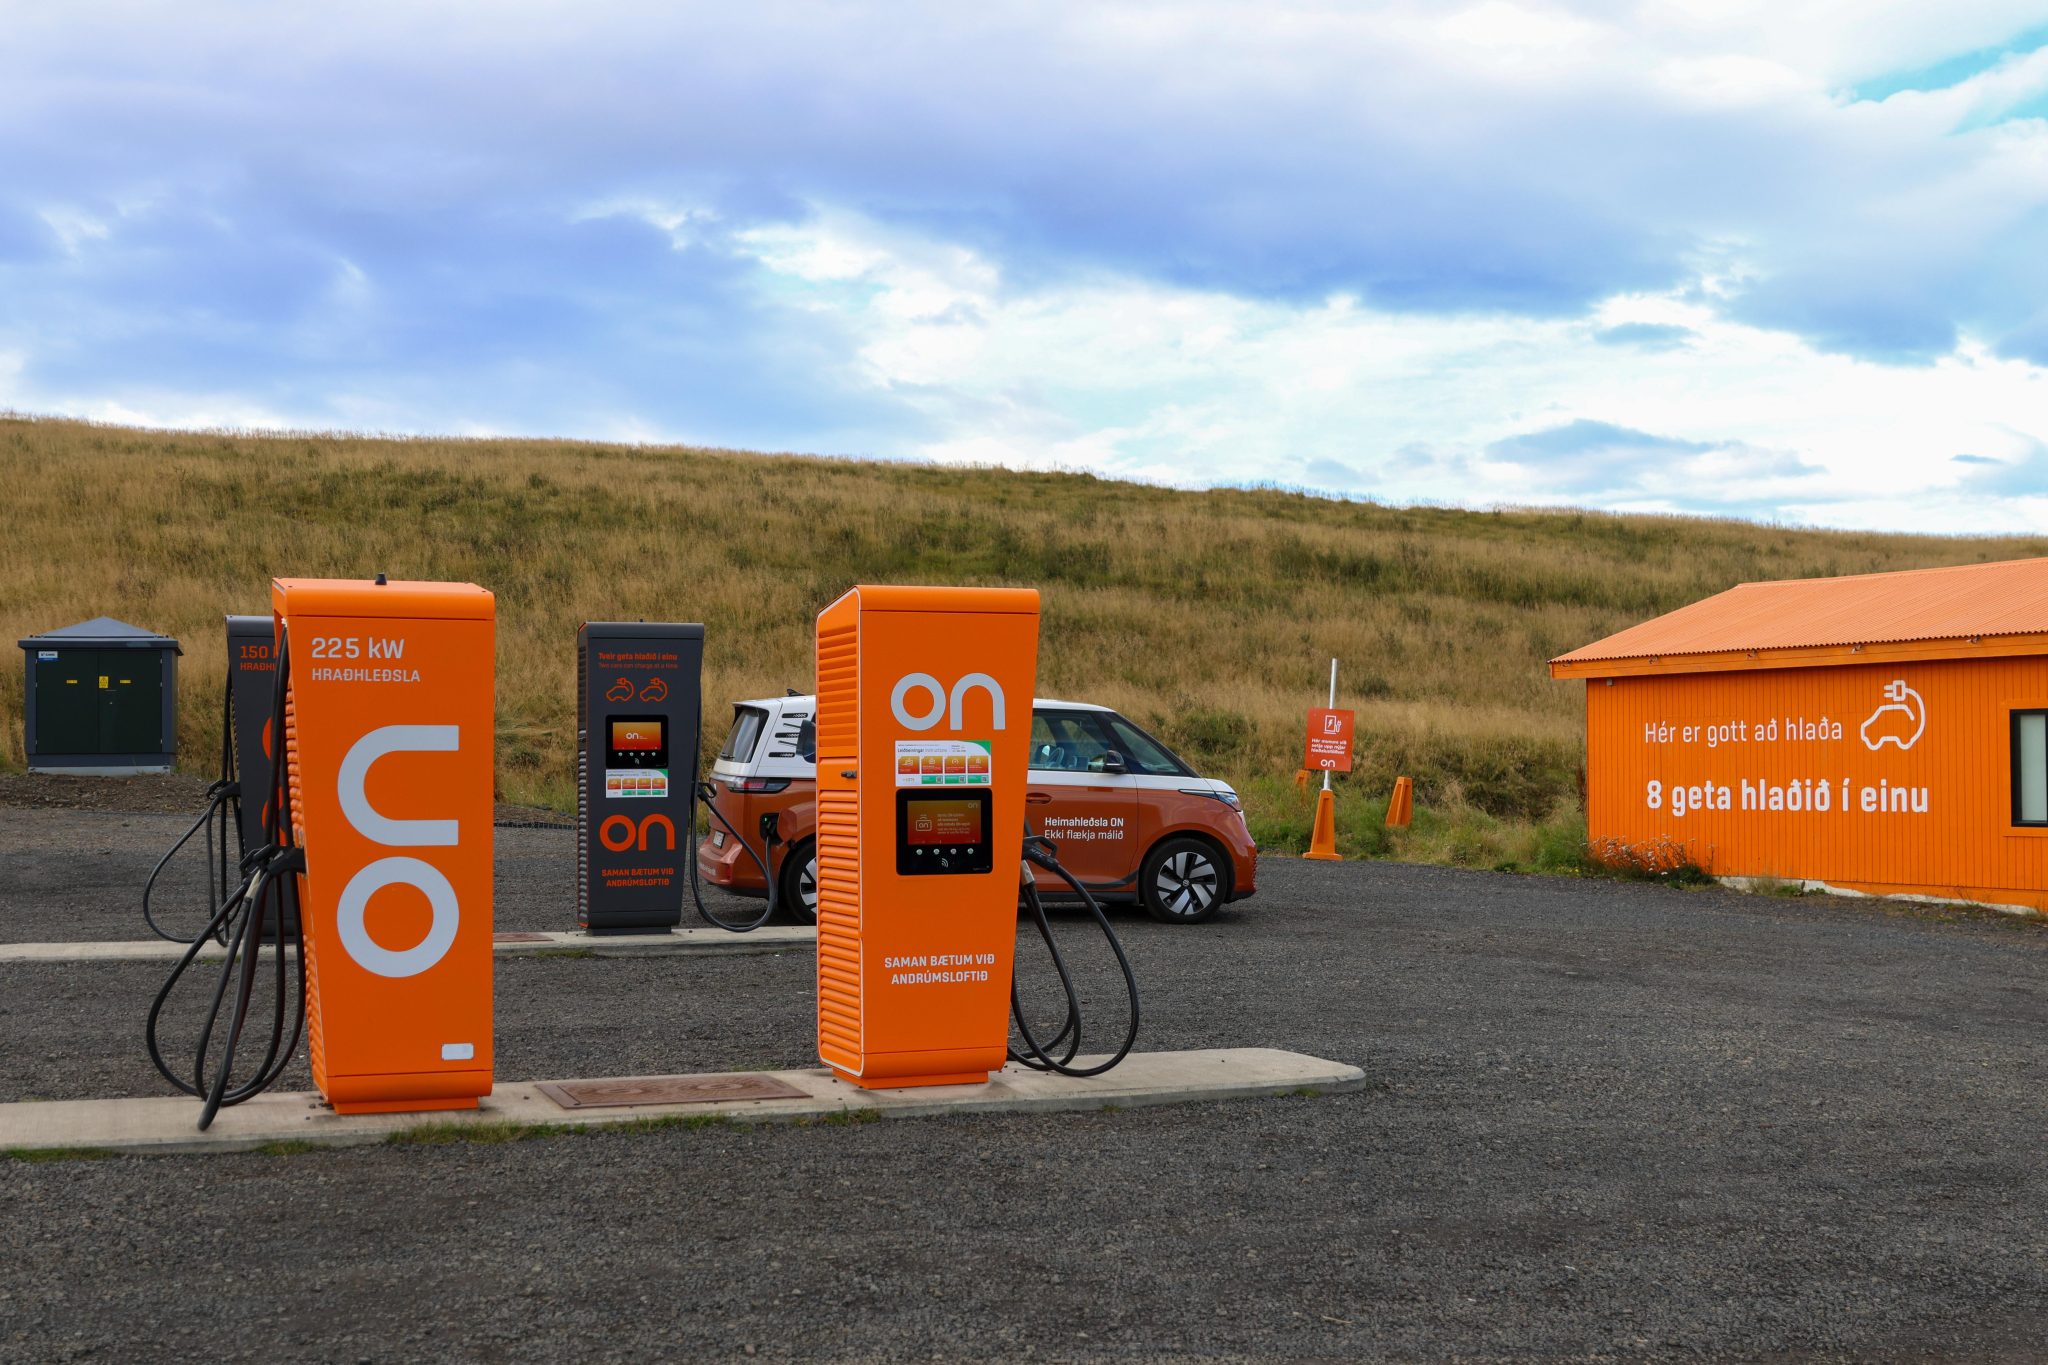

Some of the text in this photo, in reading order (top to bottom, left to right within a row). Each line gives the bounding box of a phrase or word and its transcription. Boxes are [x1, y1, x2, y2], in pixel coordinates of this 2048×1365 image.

[240, 645, 268, 659] 150
[311, 637, 405, 659] 225 kW
[617, 653, 633, 661] geta
[311, 668, 421, 682] HRAÐHLEÐSLA
[890, 672, 1006, 731] on
[626, 732, 639, 740] on
[1645, 716, 1842, 748] Hér er gott að hlaða
[1320, 759, 1336, 768] on
[1646, 777, 1928, 817] 8 geta hlaðið í einu
[1045, 816, 1124, 827] Heimahleðsla ON
[600, 813, 676, 852] on
[1044, 829, 1124, 841] Ekki flækja málið
[337, 725, 460, 977] on
[602, 869, 629, 877] SAMAN
[632, 868, 659, 876] BÆTUM
[607, 877, 669, 887] ANDRÚMSLOFTIÐ
[884, 953, 995, 968] SAMAN BÆTUM VIÐ
[891, 969, 988, 985] ANDRÚMSLOFTIÐ
